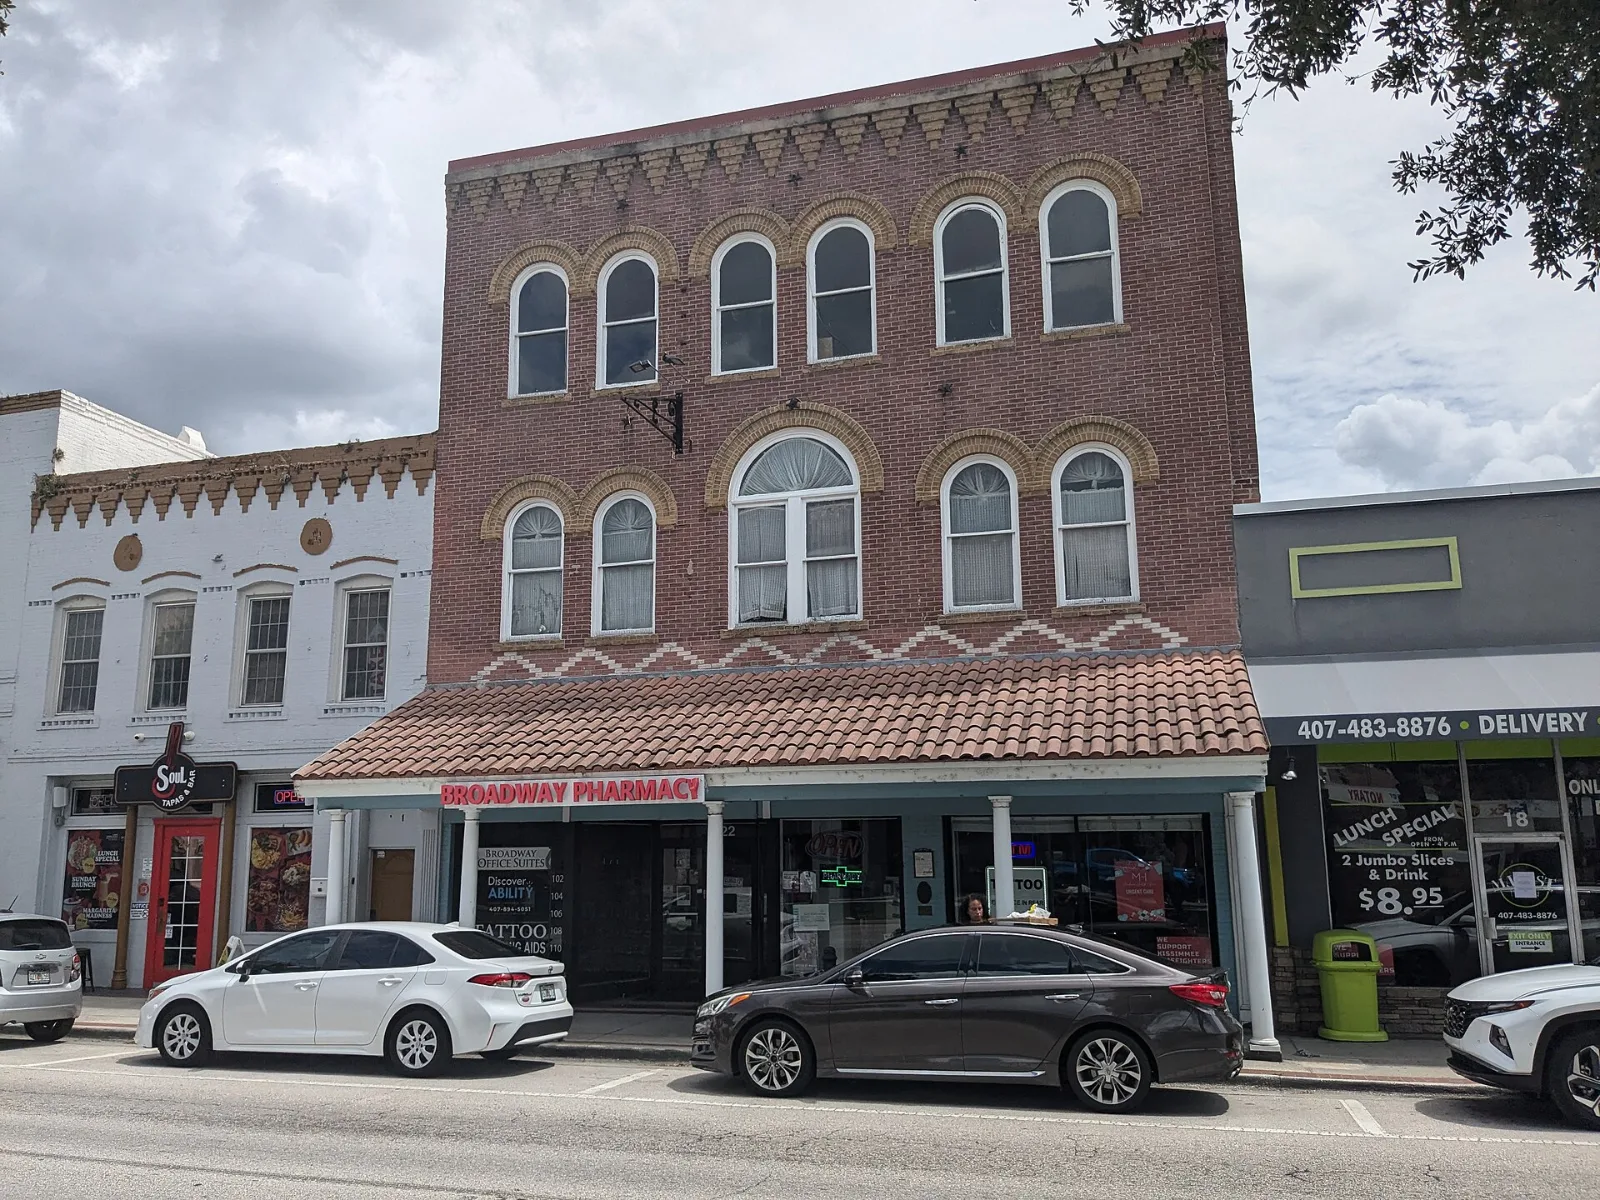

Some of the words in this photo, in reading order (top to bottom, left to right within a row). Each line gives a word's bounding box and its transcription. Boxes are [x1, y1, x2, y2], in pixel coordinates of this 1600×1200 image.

[1297, 717, 1451, 739] 407-483-8876
[1478, 712, 1588, 734] DELIVERY
[162, 795, 184, 807] TAPAS
[187, 769, 196, 788] BAR
[440, 782, 568, 805] BROADWAY
[572, 778, 700, 802] PHARMACY
[1503, 809, 1529, 827] 18
[1333, 807, 1398, 846] LUNCH
[1382, 805, 1456, 847] SPECIAL
[813, 834, 859, 858] OPEN
[1012, 845, 1031, 855] TM
[485, 849, 537, 858] BROADWAY
[1341, 854, 1351, 866] 2
[1356, 854, 1407, 866] Jumbo
[1411, 853, 1455, 866] Slices
[478, 858, 512, 868] OFFICE
[513, 857, 545, 868] SUITES
[551, 875, 564, 883] 102
[1368, 869, 1380, 880] &
[1385, 868, 1429, 880] Drink
[488, 876, 527, 886] Discover
[990, 879, 1043, 890] TTOO
[488, 887, 534, 899] ABILITY
[550, 892, 563, 900] 104
[1358, 887, 1445, 915] $8.95
[550, 910, 563, 918] 106
[549, 927, 562, 935] 108
[523, 941, 546, 954] AIDS
[549, 944, 562, 952] 110
